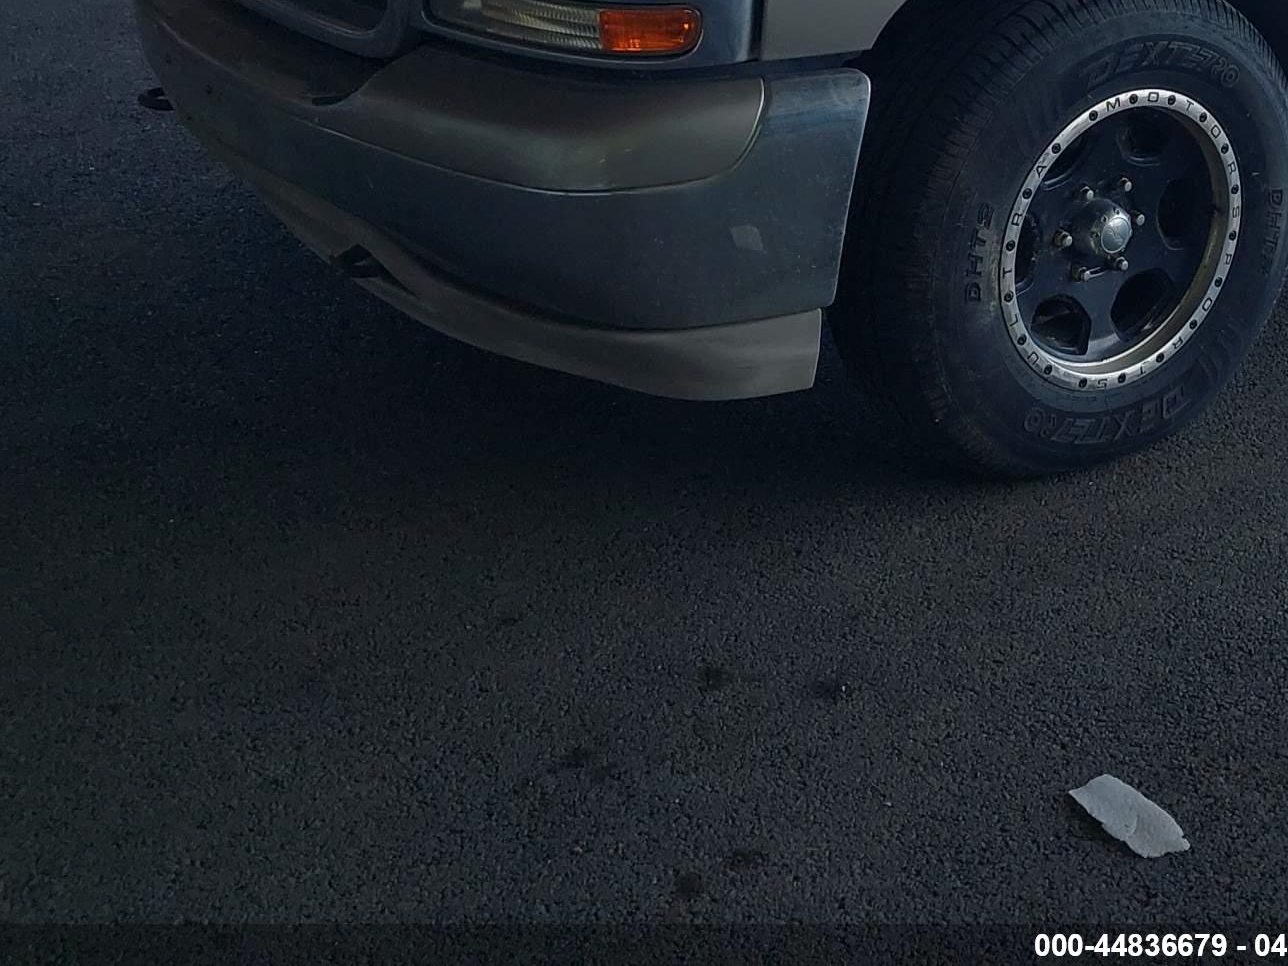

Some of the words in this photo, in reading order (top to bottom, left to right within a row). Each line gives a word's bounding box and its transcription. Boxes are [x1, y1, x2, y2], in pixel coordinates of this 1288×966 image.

[1079, 41, 1240, 90] DEXTERO
[964, 202, 994, 304] DHT2
[1003, 163, 1047, 366] ULTRA
[1023, 387, 1191, 445] DEXTERO
